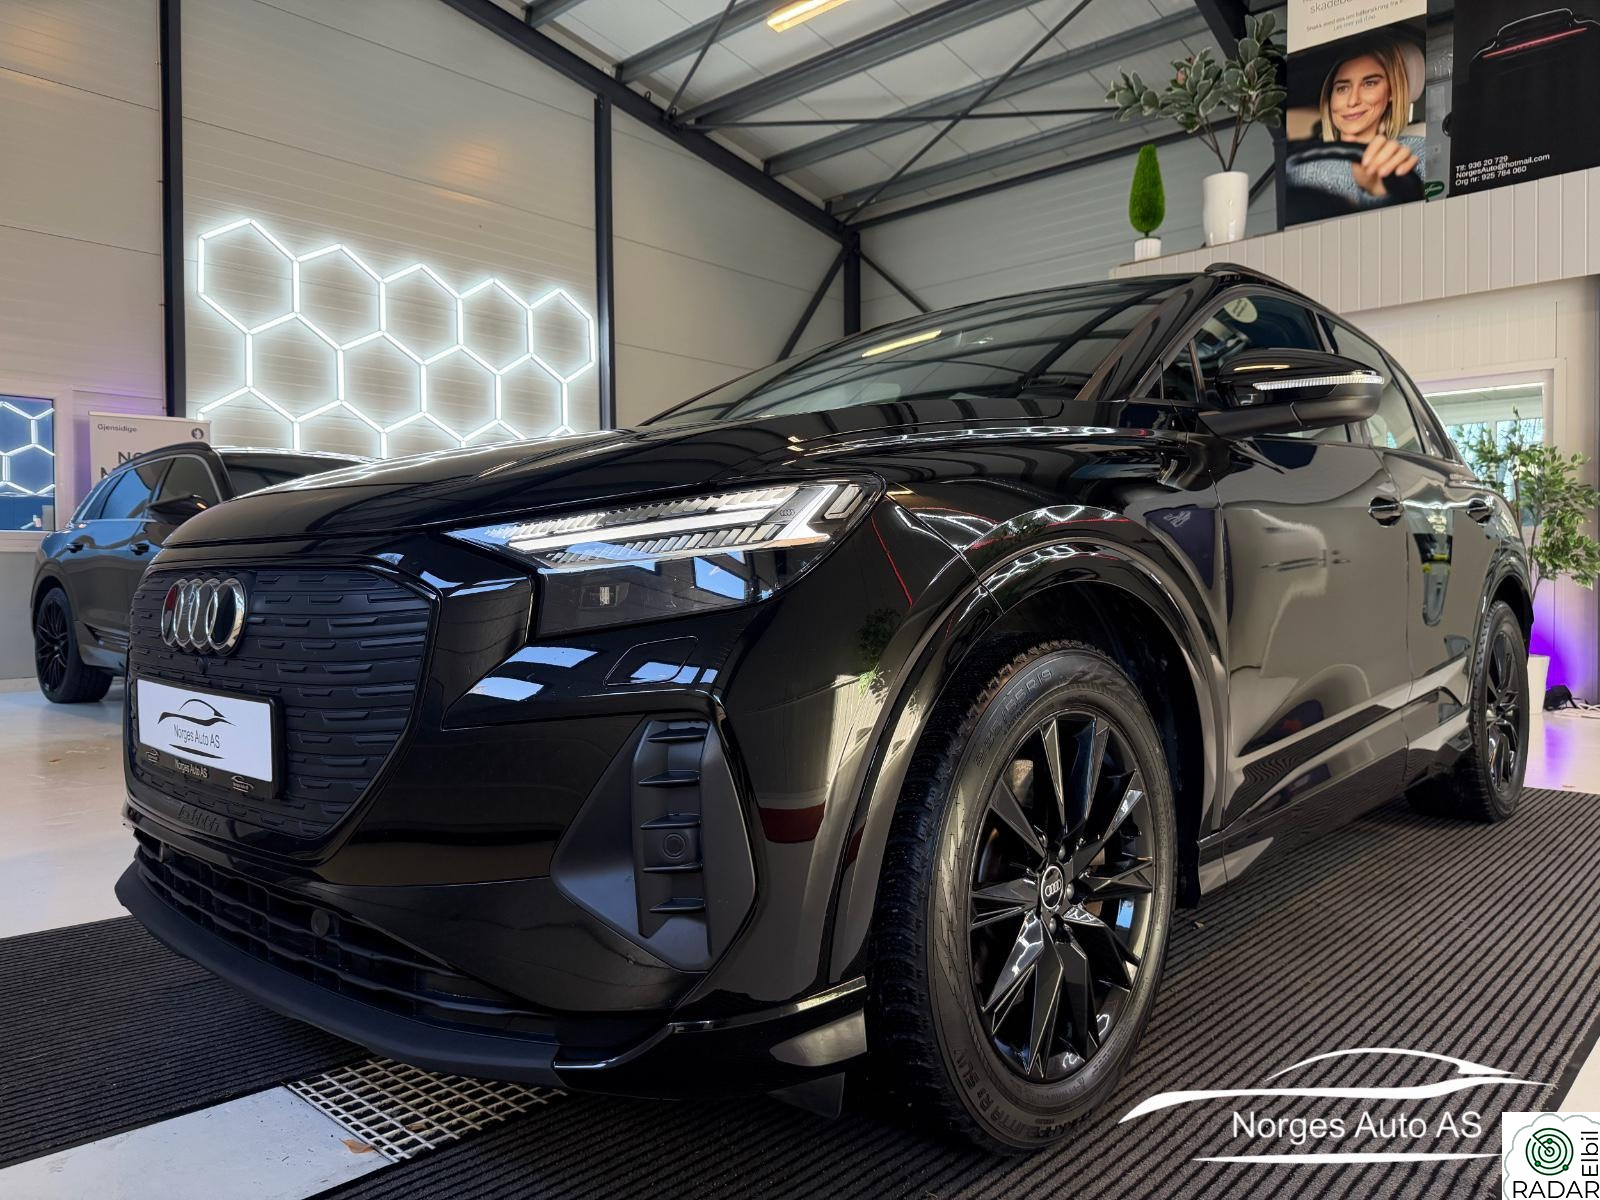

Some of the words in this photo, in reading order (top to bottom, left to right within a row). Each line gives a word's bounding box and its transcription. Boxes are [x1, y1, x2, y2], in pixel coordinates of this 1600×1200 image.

[1456, 154, 1550, 179] NorgesAuto@hotmail.com
[1468, 160, 1482, 170] 936
[1483, 158, 1493, 166] 20
[1455, 179, 1469, 187] Org
[1481, 172, 1496, 181] 925
[1512, 166, 1527, 175] 060
[97, 423, 138, 433] Gjensidige
[173, 724, 194, 744] Norges
[194, 730, 209, 746] Auto
[210, 733, 220, 749] AS
